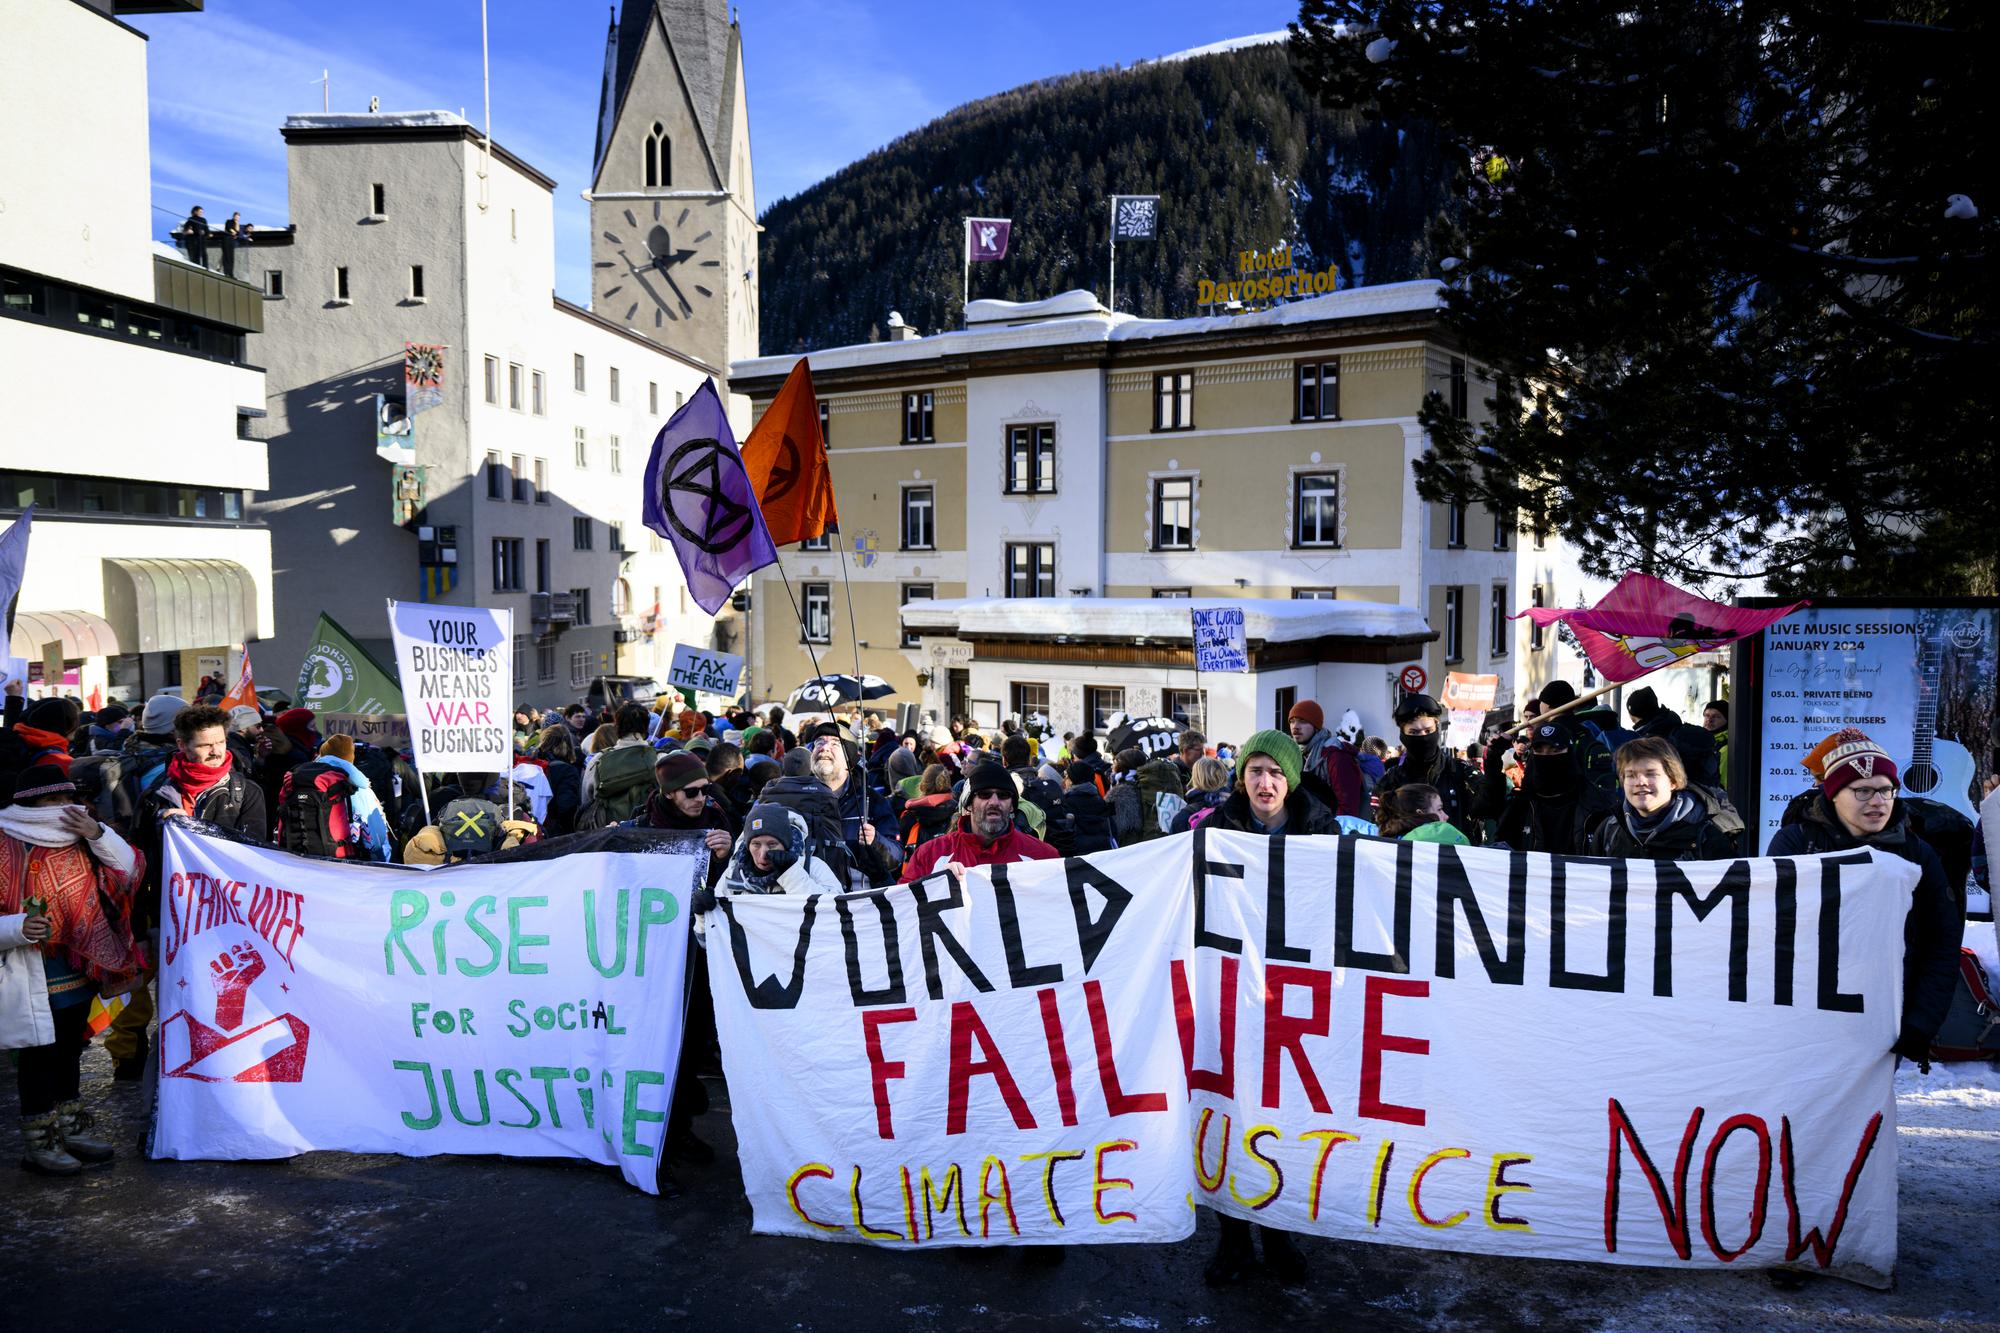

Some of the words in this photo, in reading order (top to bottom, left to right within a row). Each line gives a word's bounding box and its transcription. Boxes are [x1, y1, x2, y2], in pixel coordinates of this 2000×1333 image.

[1239, 246, 1292, 272] Hotel
[1197, 263, 1339, 305] Davoserhof
[1194, 611, 1213, 627] ONE
[1216, 610, 1244, 625] WORLD
[1770, 623, 1800, 635] LIVE
[1804, 623, 1852, 635] MUSIC
[1855, 623, 1925, 635] SESSIONS
[429, 619, 478, 645] YOUR
[1218, 626, 1235, 639] ALL
[1770, 641, 1829, 651] JANUARY
[1833, 641, 1865, 651] 2024
[688, 655, 727, 677] TAX
[1203, 658, 1246, 671] EVERYTHING
[419, 675, 491, 699] MEANS
[672, 668, 700, 684] THE
[702, 674, 733, 693] RICH
[1804, 691, 1841, 699] PRIVATE
[1844, 691, 1873, 699] BLEND
[426, 702, 492, 726] WAR
[1804, 716, 1841, 724] MIDLIVE
[1843, 716, 1886, 724] CRUISERS
[165, 871, 248, 966] STRIKE
[716, 856, 1133, 1010] WORLD
[1194, 828, 1873, 1013] ECONOMIC
[384, 888, 549, 978] RiSE
[583, 888, 679, 978] UP
[411, 1002, 478, 1038] FOR
[862, 955, 1430, 1139] FAILURE
[786, 1138, 1139, 1243] CLIMATE
[1186, 1106, 1533, 1233] USTICE
[1603, 1097, 1883, 1270] NOW
